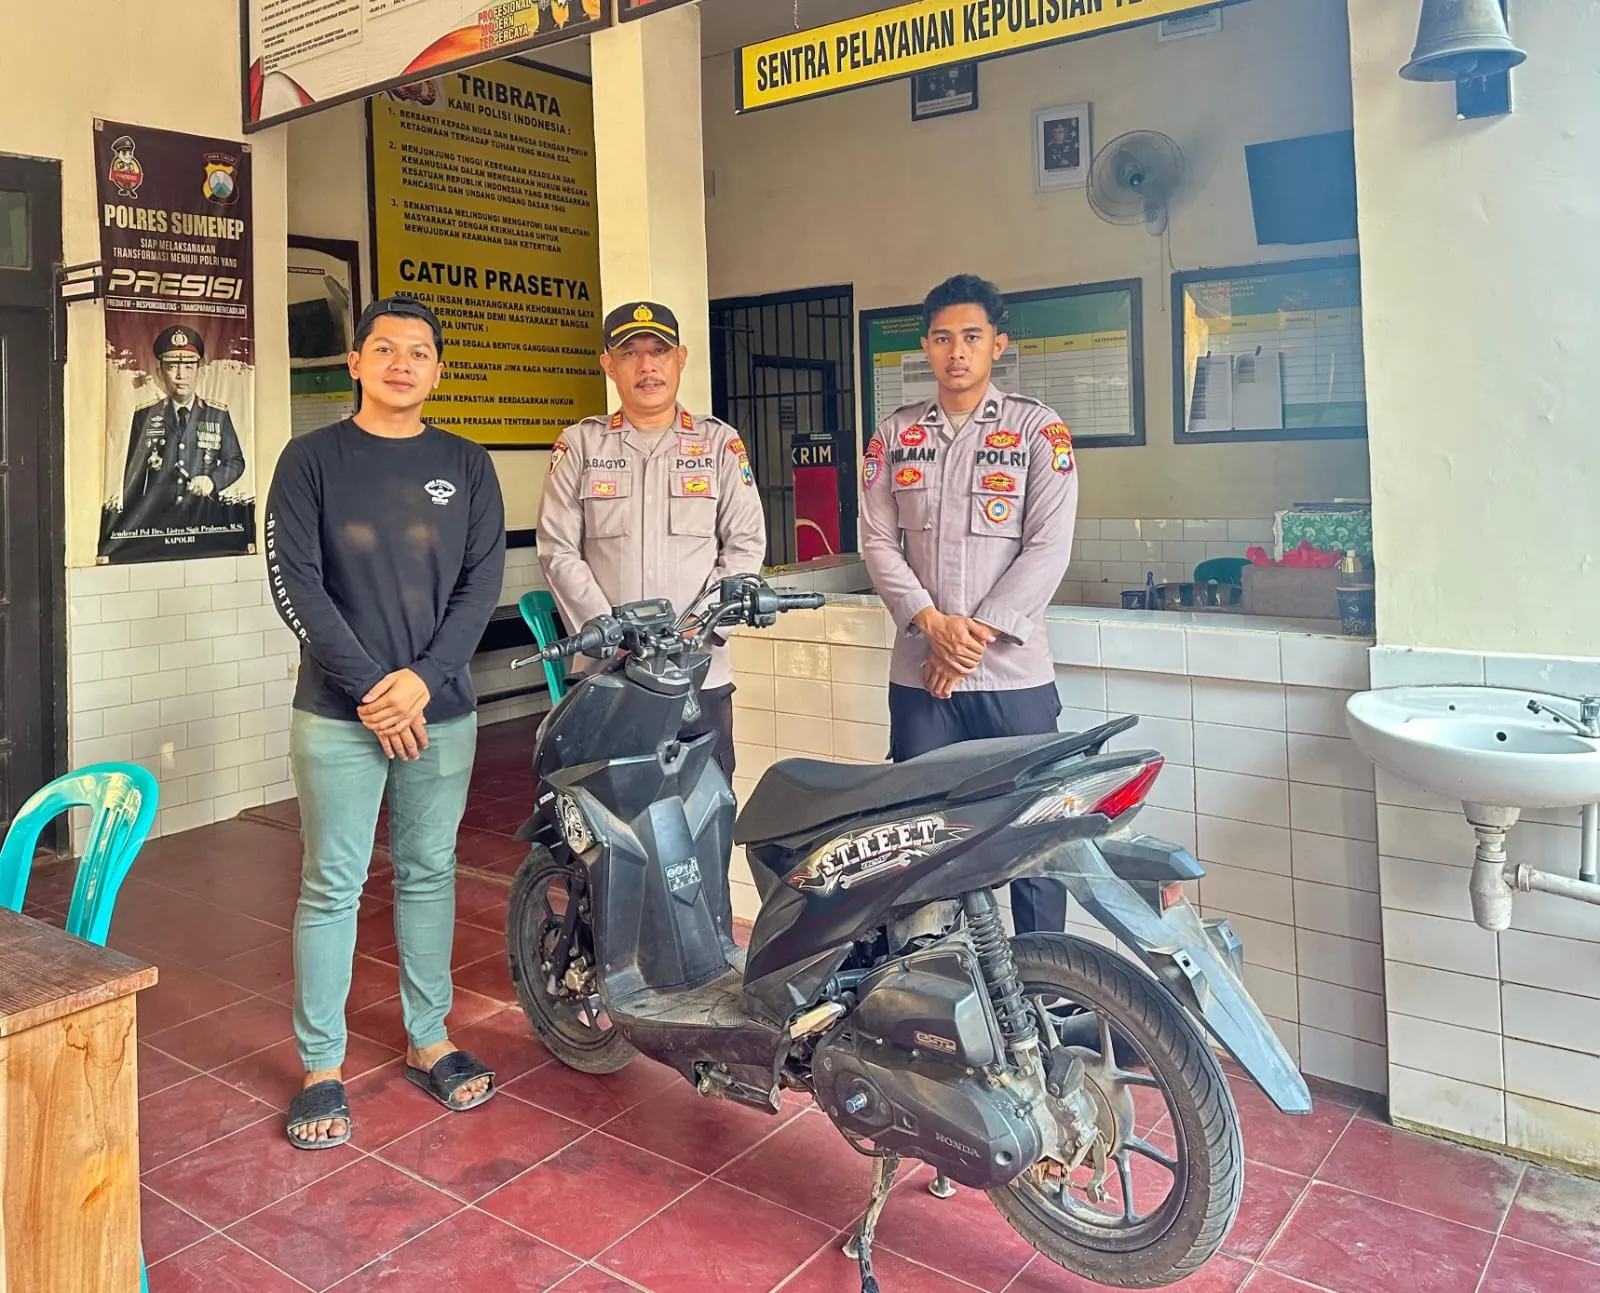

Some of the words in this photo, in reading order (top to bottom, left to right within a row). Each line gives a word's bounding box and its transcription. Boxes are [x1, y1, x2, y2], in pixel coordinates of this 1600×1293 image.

[478, 0, 531, 22] PROFESIONAL
[481, 14, 514, 35] MODERN
[757, 41, 829, 91] SENTRA
[837, 8, 953, 72] PELAYANAN
[963, 0, 1102, 43] KEPOLIS
[457, 73, 561, 117] TRIBRATA
[389, 108, 395, 116] 1.
[400, 110, 439, 125] BERBAKTI
[441, 120, 470, 132] KEPADA
[472, 126, 491, 136] NUSA
[493, 131, 508, 139] DAN
[509, 134, 536, 146] BANGSA
[538, 140, 565, 152] DENGAN
[448, 98, 474, 113] KAMI
[479, 107, 511, 121] POLISI
[514, 114, 565, 133] INDONESIA
[400, 121, 448, 138] KETAQWAAN
[451, 132, 488, 146] TERHADAP
[492, 141, 515, 151] TUHAN
[517, 146, 535, 156] YANG
[537, 150, 555, 161] MAHA
[389, 142, 396, 150] 2.
[401, 144, 454, 160] MENJUNJUNG
[457, 155, 483, 166] TINGGI
[484, 160, 526, 175] KEBENARAN
[528, 168, 561, 182] KEADILAN
[563, 176, 575, 184] DAN
[402, 156, 458, 172] KEMANUSIAAN
[460, 166, 485, 178] DALAM
[487, 171, 534, 187] MENEGAKKAN
[402, 167, 444, 180] KESATUAN
[446, 175, 482, 188] REPUBLIK
[484, 182, 522, 196] INDONESIA
[524, 189, 542, 199] YANG
[402, 178, 446, 193] PANCASILA
[448, 186, 464, 195] DAN
[466, 189, 495, 201] UNDANG
[498, 195, 525, 206] UNDANG
[528, 200, 549, 210] DASAR
[104, 204, 168, 233] POLRES
[172, 211, 244, 240] SUMENEP
[391, 199, 398, 208] 3.
[404, 201, 453, 216] SENANTIASA
[455, 209, 500, 223] MELINDUNGI
[503, 217, 542, 230] MENGAYOMI
[544, 223, 558, 232] DAN
[404, 212, 456, 227] MASYARAKAT
[458, 221, 488, 232] DENGAN
[490, 225, 534, 239] KEIKHLASAN
[536, 232, 559, 243] UNTUK
[140, 238, 158, 248] SIAP
[159, 240, 216, 254] MELAKSANAKAN
[404, 224, 460, 239] MEWUJUDKAN
[462, 233, 502, 245] KEAMANAN
[504, 239, 518, 248] DAN
[520, 240, 561, 253] KETERTIBAN
[113, 248, 169, 262] TRANSFORMASI
[170, 252, 198, 264] MENUJU
[199, 255, 220, 266] POLRI
[221, 257, 238, 268] YANG
[108, 268, 243, 300] PRESISI
[400, 259, 478, 289] CATUR
[485, 269, 589, 301] PRASETYA
[434, 307, 485, 320] BERKORBAN
[487, 312, 506, 321] DEMI
[508, 315, 558, 327] MASYARAKAT
[561, 320, 589, 329] BANGSA
[436, 295, 463, 305] INSAN
[465, 299, 524, 311] BHAYANGKARA
[526, 305, 576, 318] KEHORMATAN
[578, 309, 594, 318] SAYA
[455, 322, 484, 332] UNTUK
[460, 339, 491, 349] SEGALA
[493, 341, 521, 351] BENTUK
[522, 343, 560, 354] GANGGUAN
[561, 346, 596, 355] KEAMANAN
[449, 360, 502, 371] KESELAMATAN
[504, 363, 521, 372] JIWA
[522, 364, 541, 373] RAGA
[542, 366, 564, 375] HARTA
[566, 367, 587, 376] BENDA
[588, 367, 600, 376] DAN
[454, 372, 488, 381] MANUSIA
[453, 394, 495, 404] KEPASTIAN
[498, 396, 549, 405] BERDASARKAN
[550, 397, 574, 406] HUKUM
[420, 416, 461, 425] MELIHARA
[463, 416, 502, 425] PERASAAN
[504, 416, 540, 425] TENTERAM
[542, 417, 556, 425] DAN
[976, 449, 1026, 467] POLRI
[164, 536, 196, 545] KAPOLRI
[821, 819, 935, 876] STREET
[935, 1132, 982, 1158] HONDA
